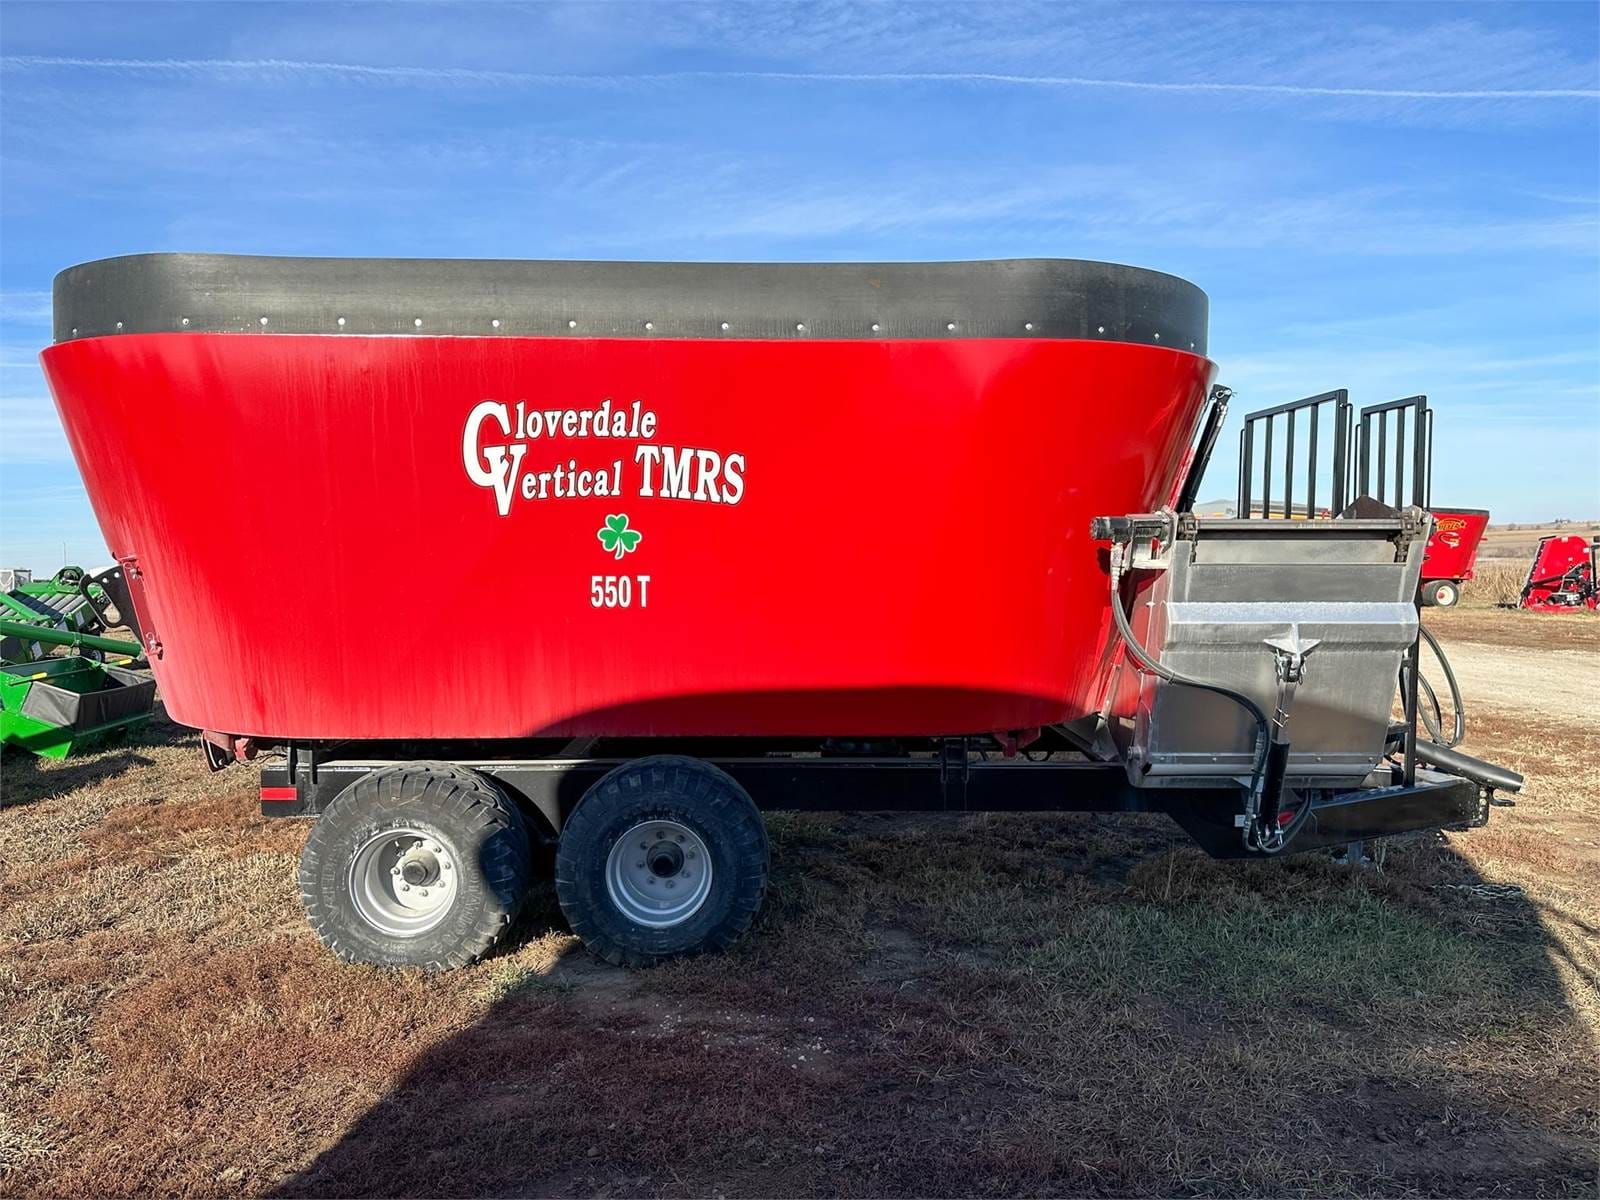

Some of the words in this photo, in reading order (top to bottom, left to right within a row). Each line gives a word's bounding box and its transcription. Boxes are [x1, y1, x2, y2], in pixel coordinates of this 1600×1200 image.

[462, 399, 657, 488] Cloverdale
[482, 443, 622, 516] Vertical
[633, 444, 747, 506] TMRS
[590, 575, 631, 609] 550
[636, 575, 651, 608] T
